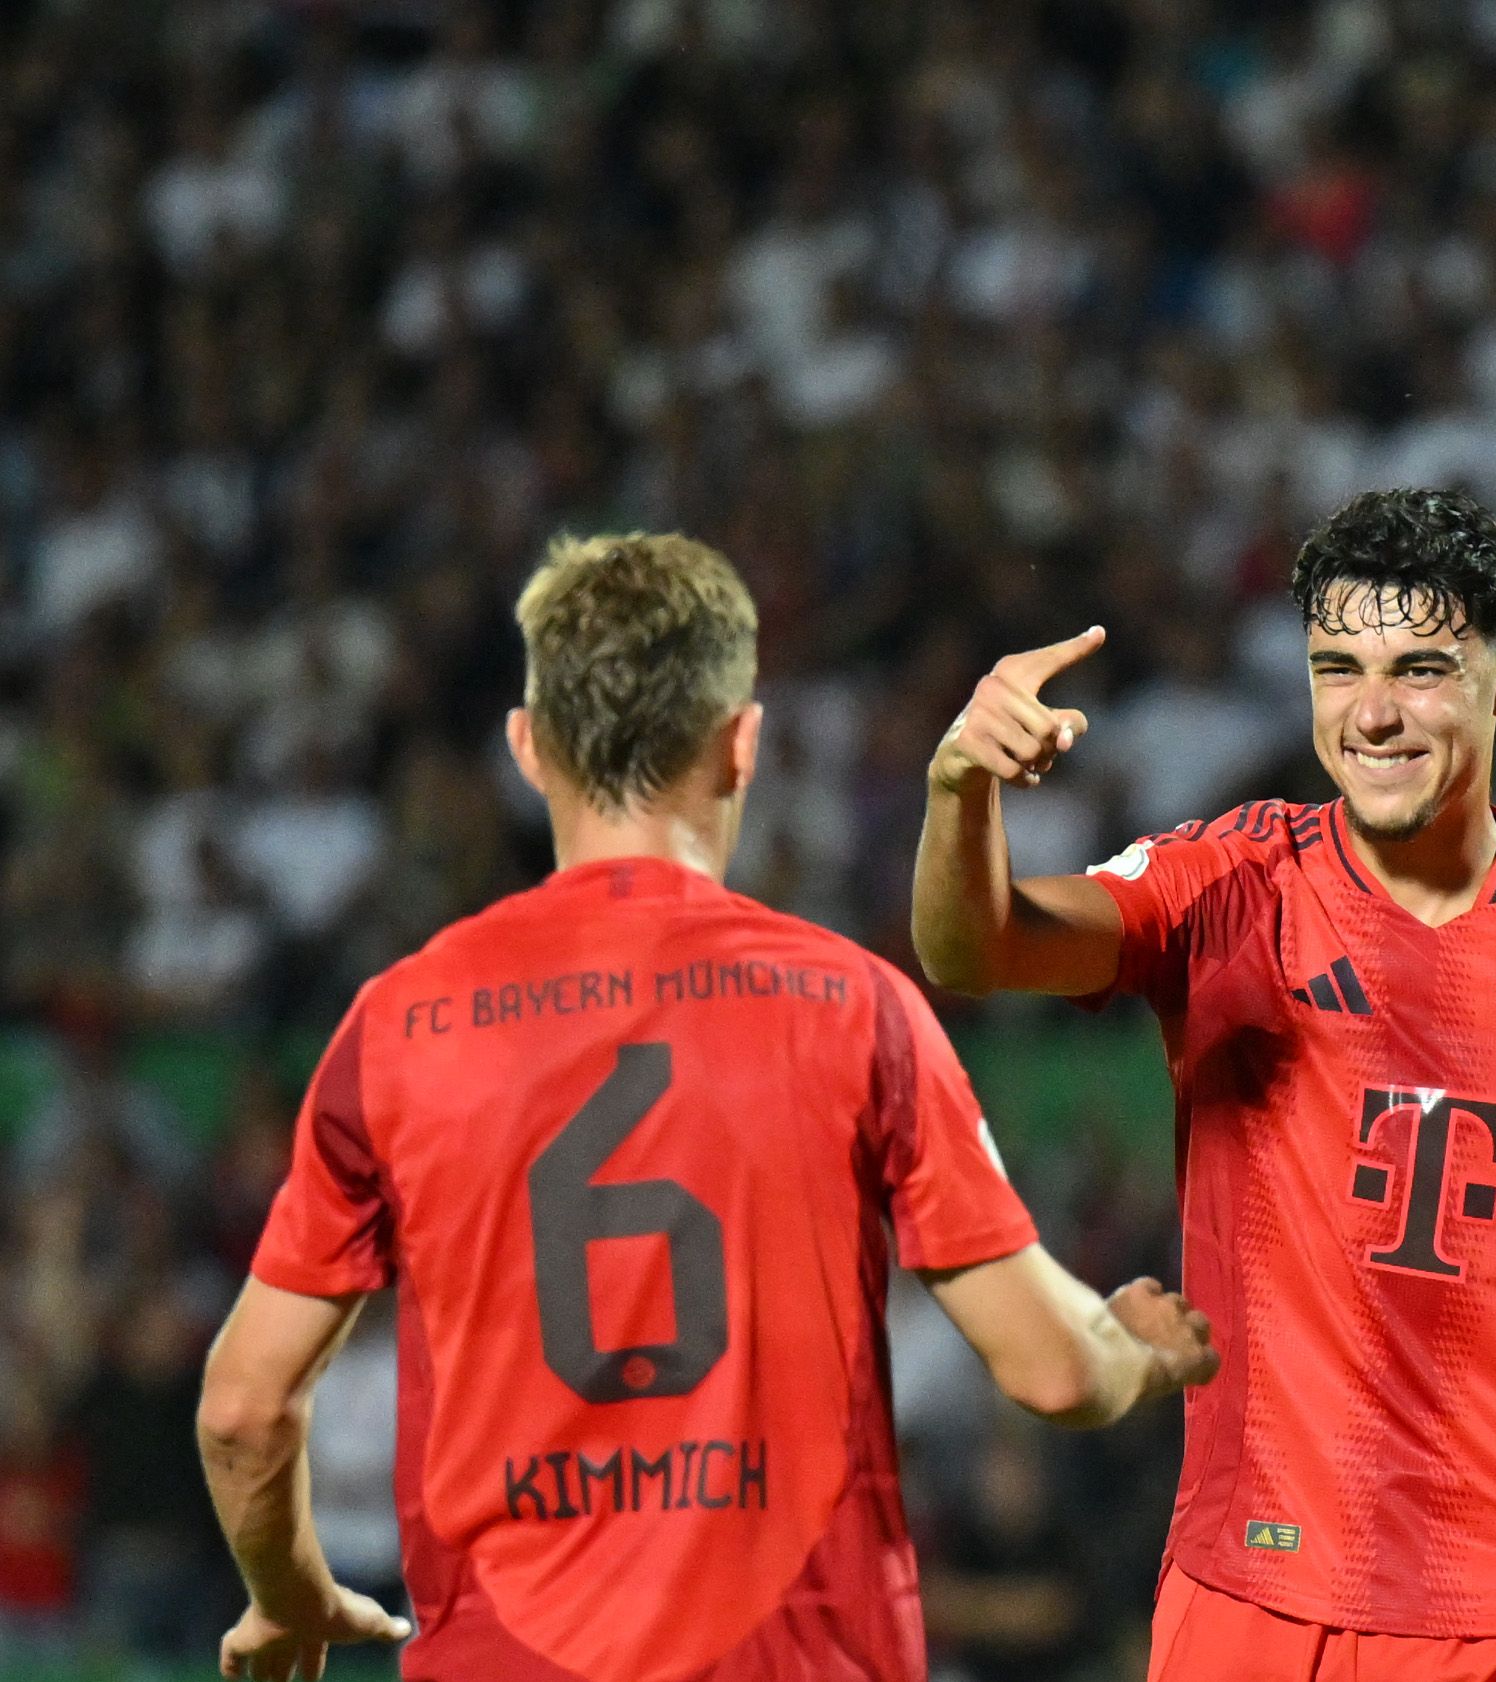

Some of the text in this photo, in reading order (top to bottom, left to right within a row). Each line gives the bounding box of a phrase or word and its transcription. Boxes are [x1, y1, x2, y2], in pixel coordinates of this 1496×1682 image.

[404, 959, 848, 1040] FC BAYERN MÜNCHEN
[527, 1041, 729, 1405] 6
[504, 1437, 768, 1520] KIMMICH
